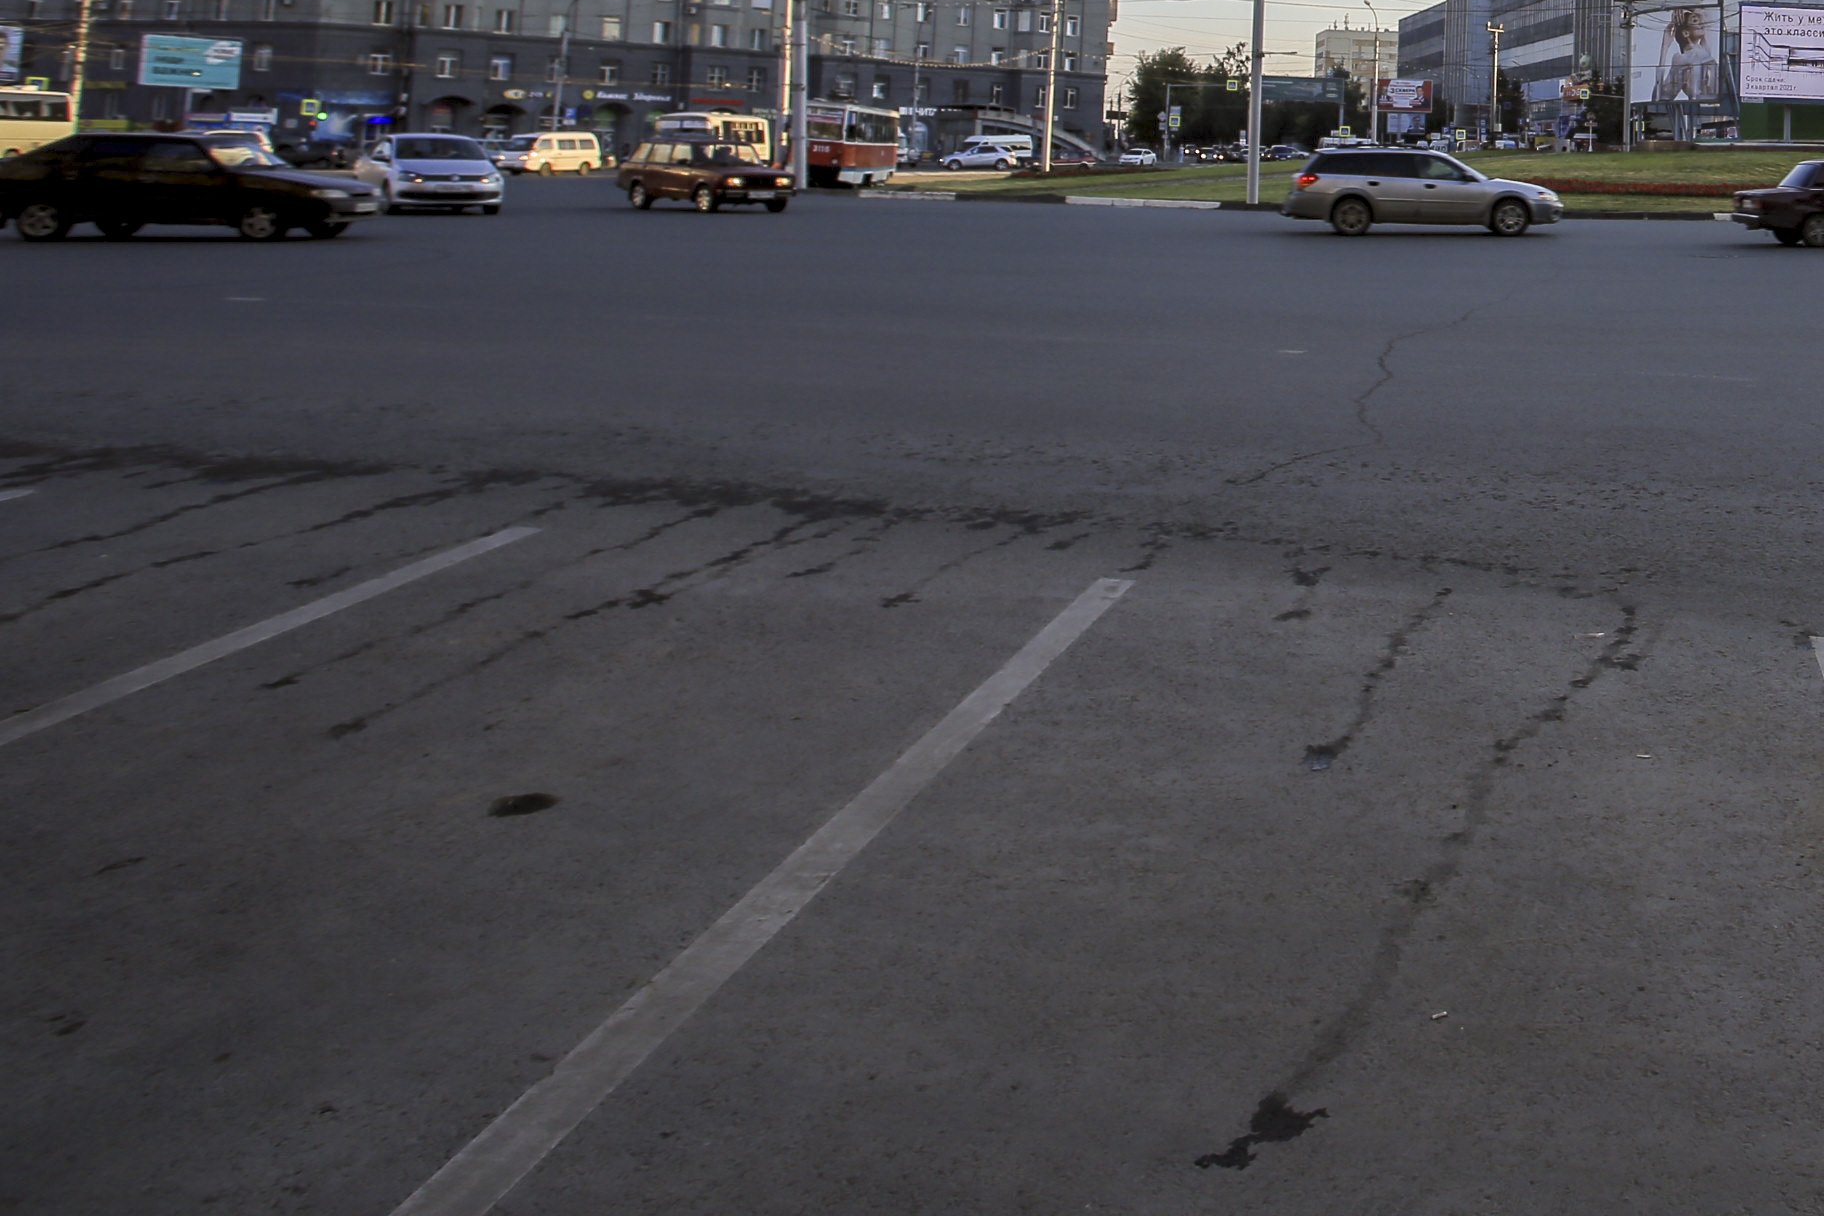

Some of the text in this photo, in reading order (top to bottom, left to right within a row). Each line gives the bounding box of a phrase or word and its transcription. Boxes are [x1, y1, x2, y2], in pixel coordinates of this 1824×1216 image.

[1764, 11, 1793, 23] Жить
[1798, 15, 1804, 25] у
[1764, 27, 1783, 36] это
